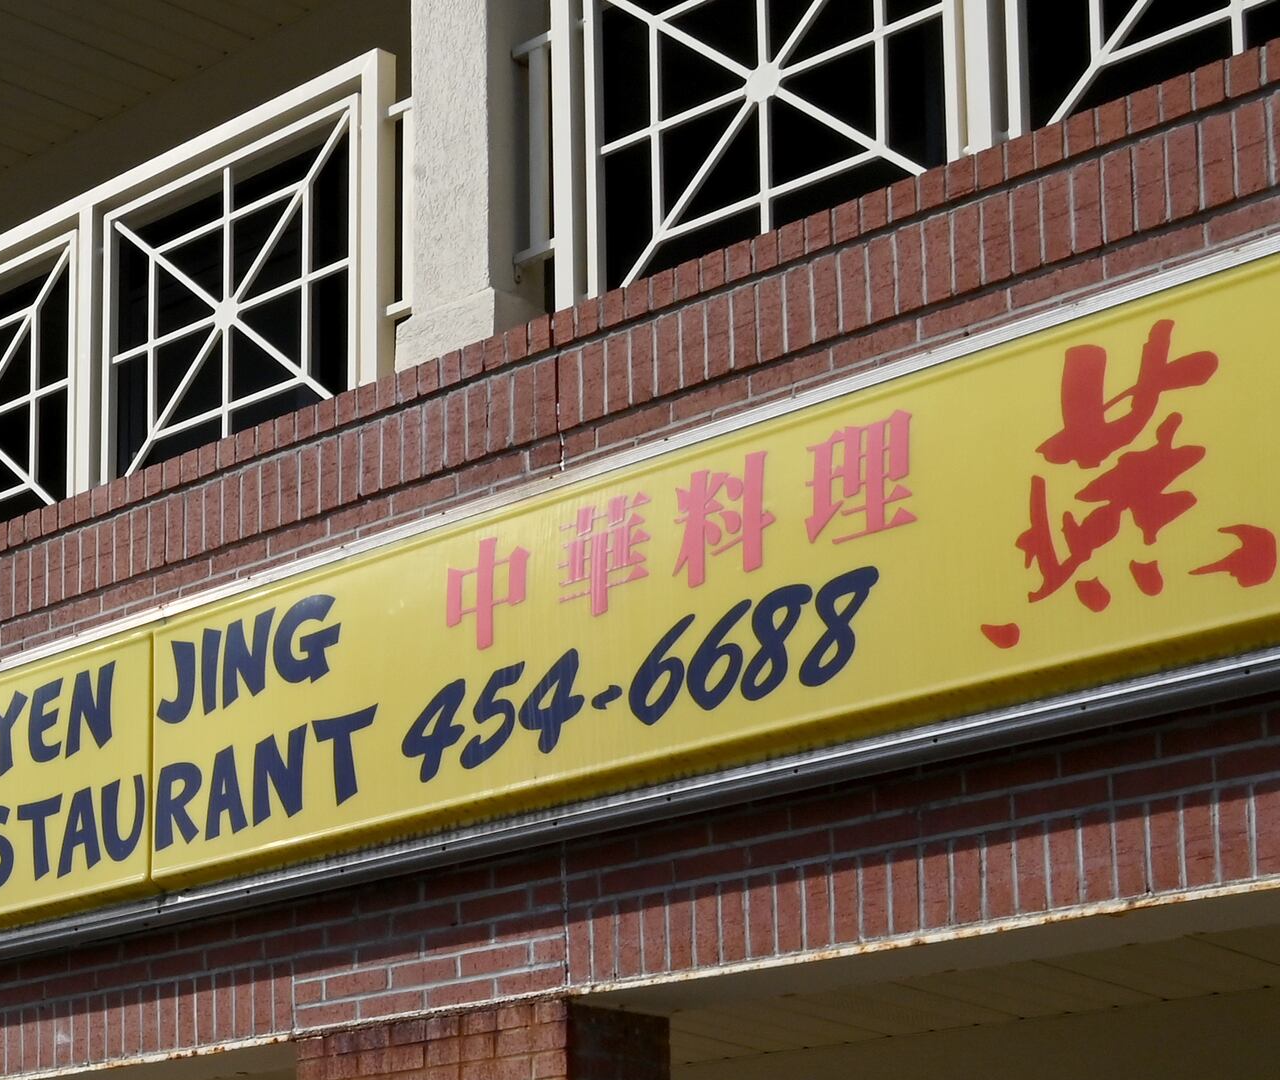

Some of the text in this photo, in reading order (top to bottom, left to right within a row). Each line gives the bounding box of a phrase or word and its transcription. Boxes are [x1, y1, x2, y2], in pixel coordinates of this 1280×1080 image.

[445, 409, 918, 650] 中華料理
[157, 594, 341, 724] JING
[401, 565, 880, 783] 454-6688
